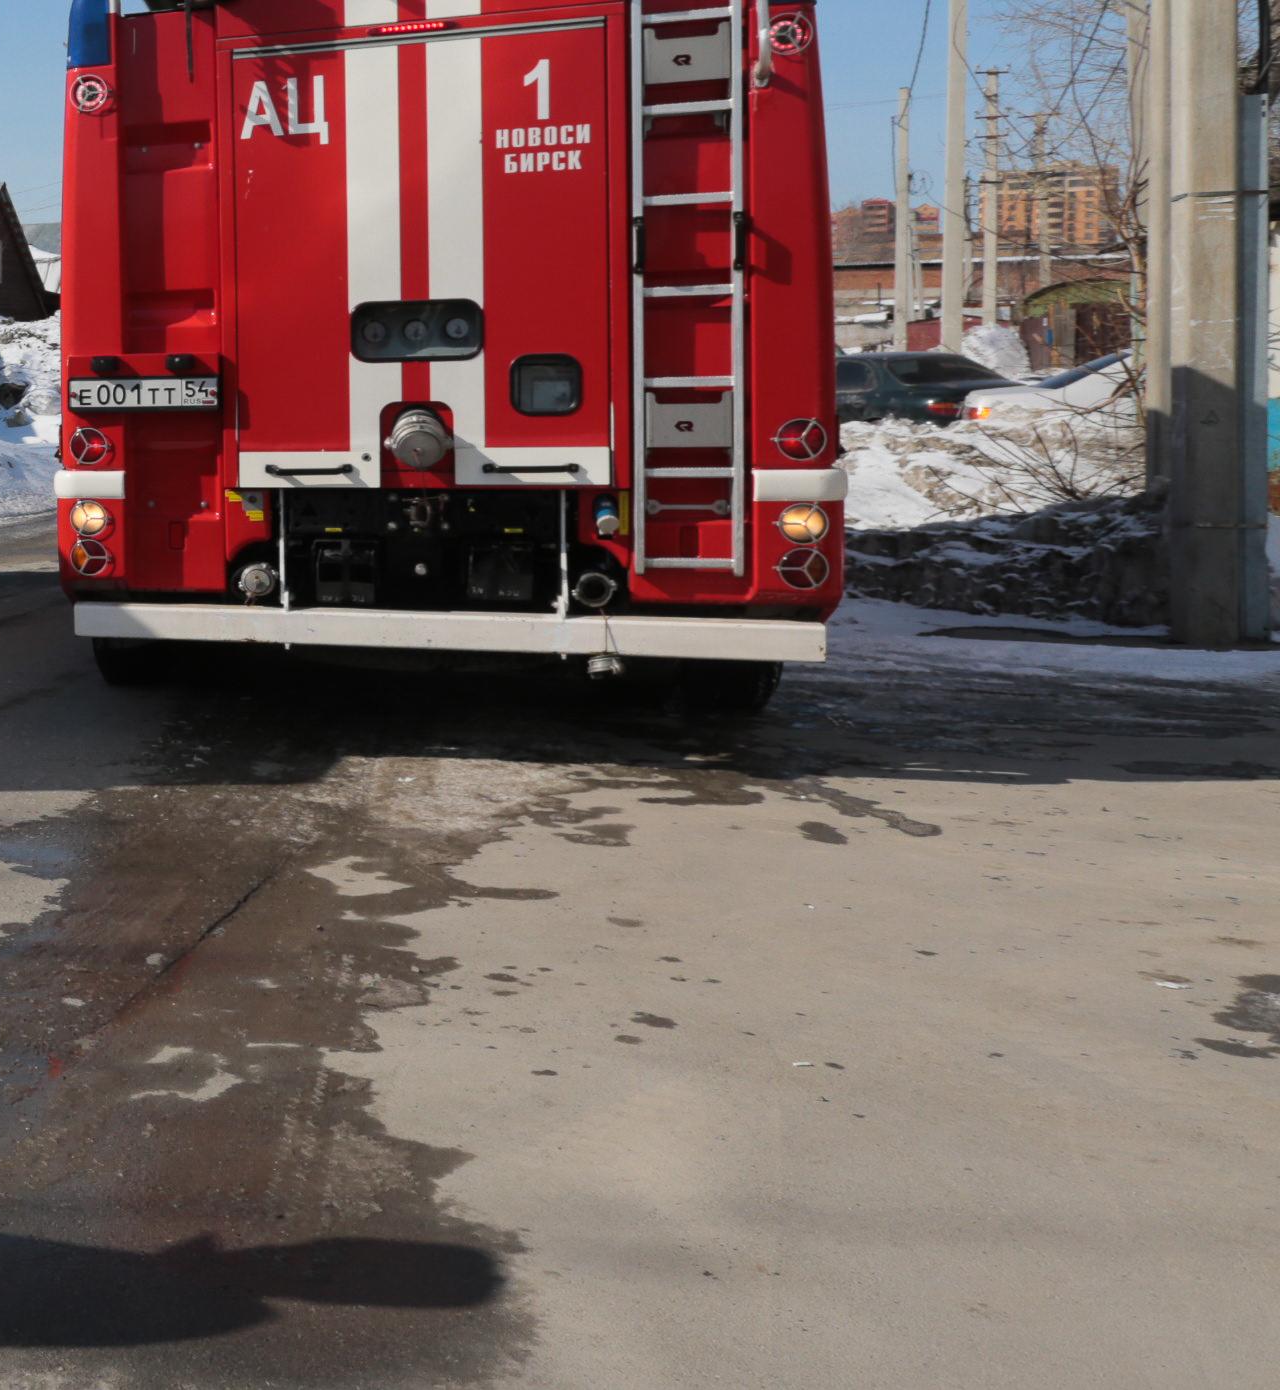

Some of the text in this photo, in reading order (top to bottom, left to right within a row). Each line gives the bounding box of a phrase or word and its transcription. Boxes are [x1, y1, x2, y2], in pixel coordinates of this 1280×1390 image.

[523, 59, 550, 120] 1
[240, 75, 329, 144] АЦ
[496, 123, 591, 148] НОВОСИ
[504, 150, 582, 174] БИРСК
[185, 381, 209, 398] 54
